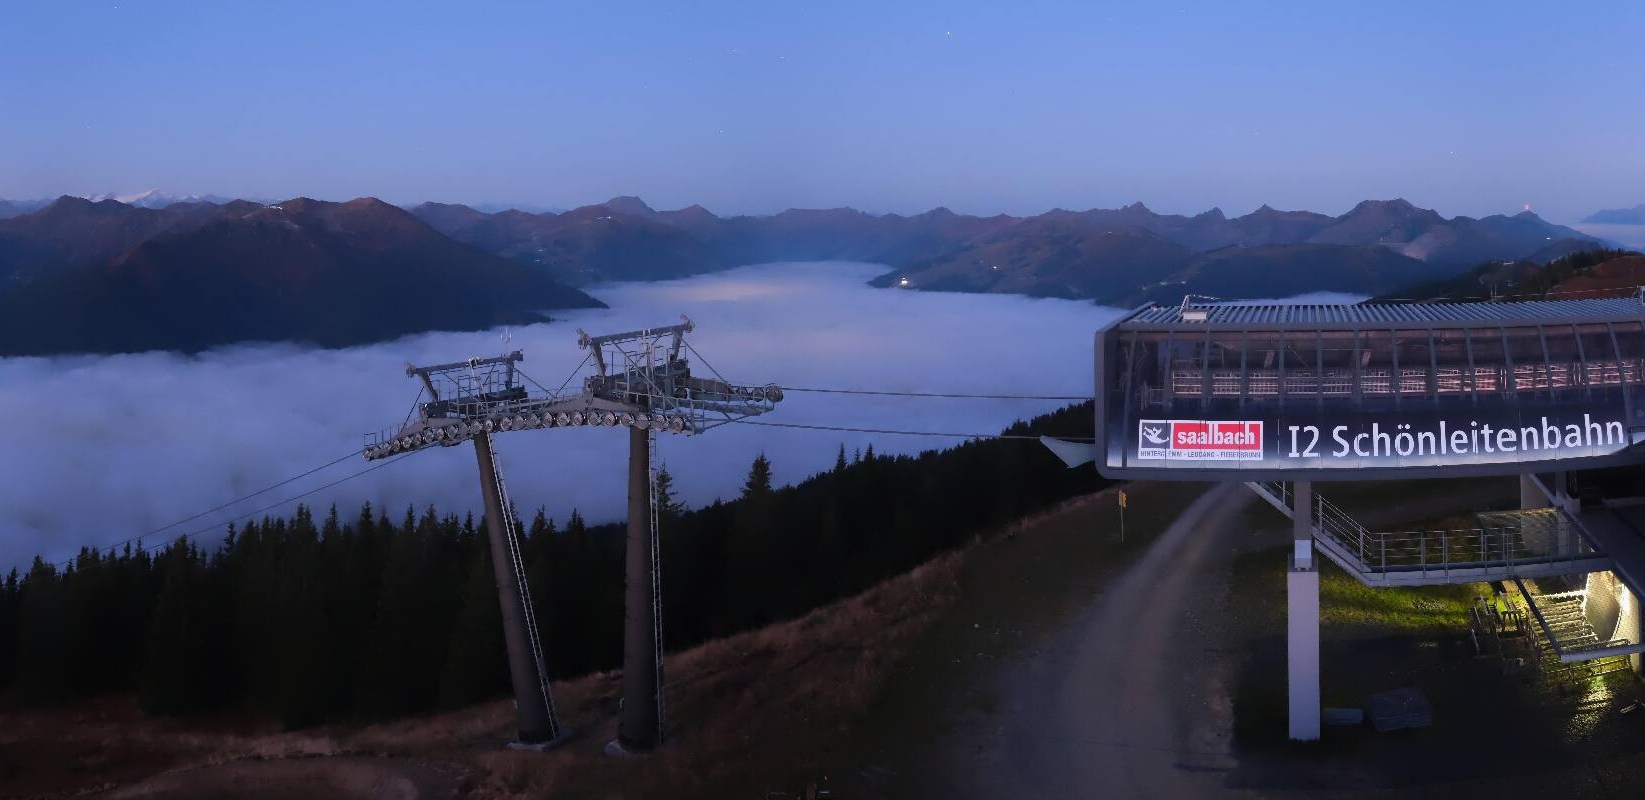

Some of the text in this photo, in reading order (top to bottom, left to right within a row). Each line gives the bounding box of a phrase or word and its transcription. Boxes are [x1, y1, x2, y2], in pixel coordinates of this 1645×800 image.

[1177, 422, 1255, 445] saalbach
[1288, 413, 1625, 457] I2 Schönleitenbahn
